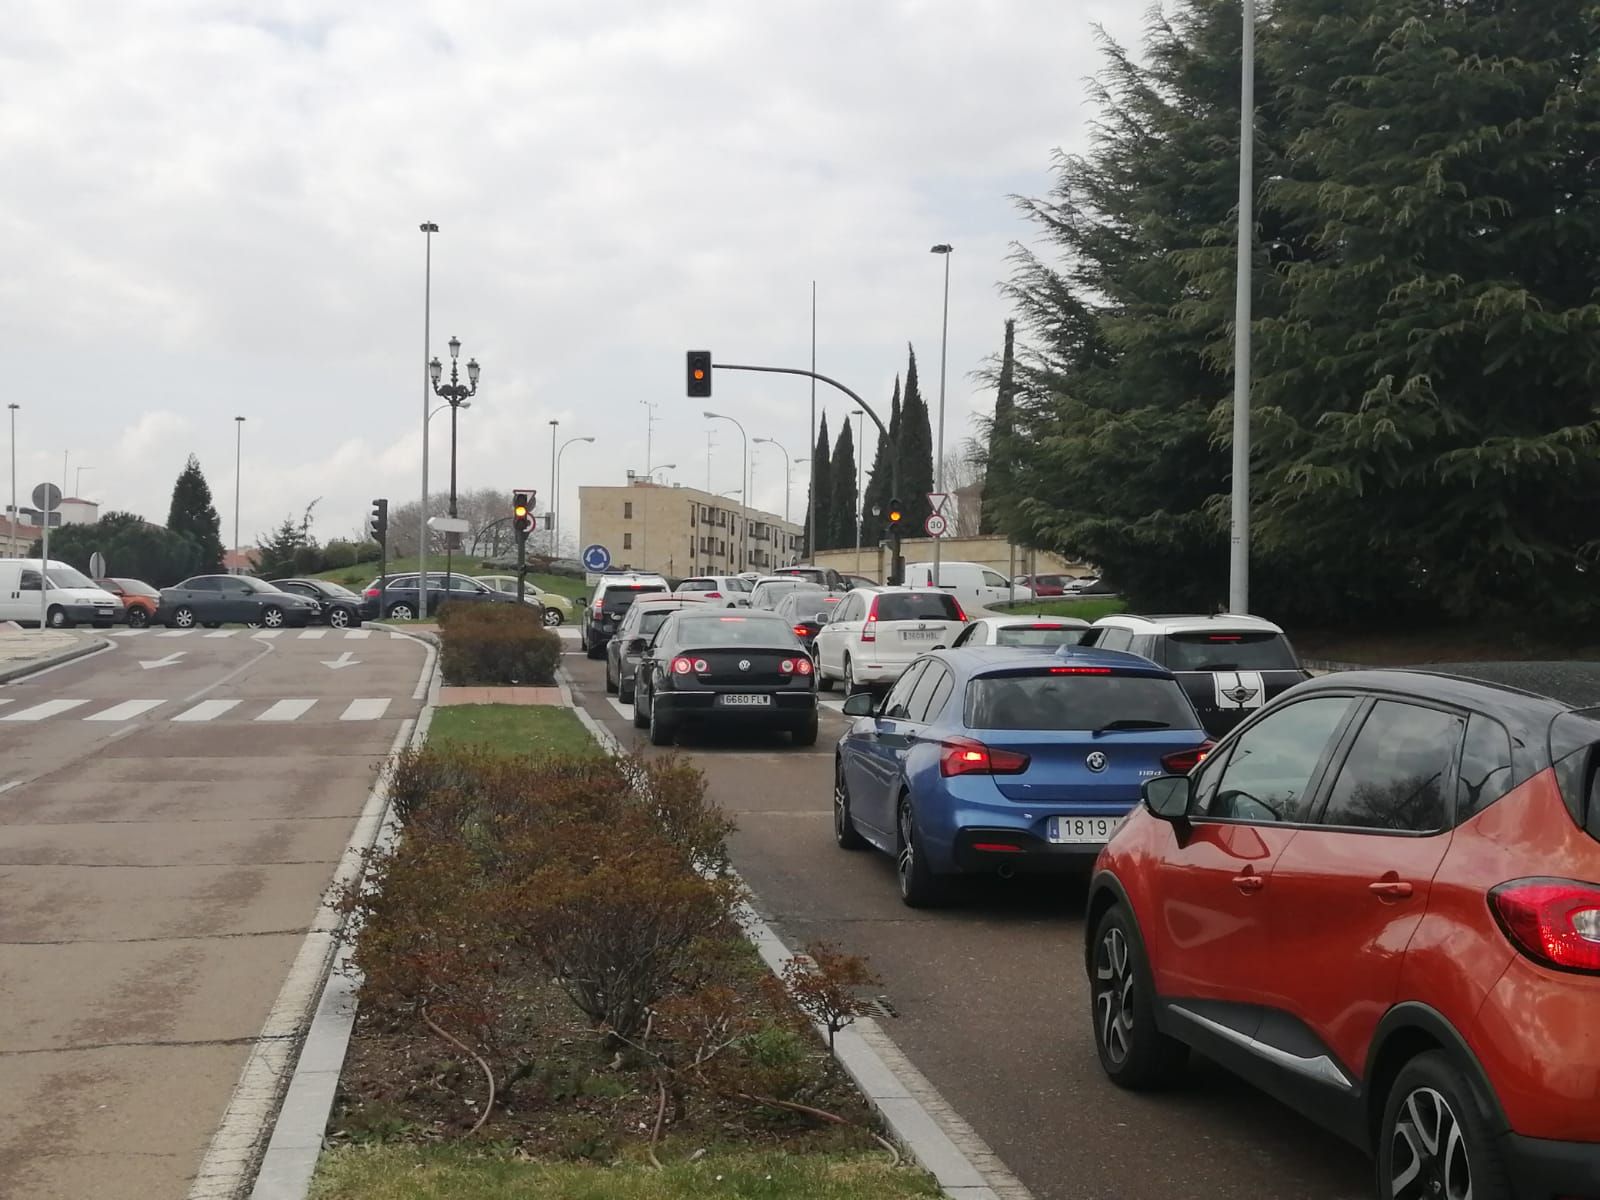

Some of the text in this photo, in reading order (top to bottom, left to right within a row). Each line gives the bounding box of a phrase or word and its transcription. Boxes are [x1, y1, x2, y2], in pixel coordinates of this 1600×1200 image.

[930, 521, 942, 529] 30
[726, 695, 749, 704] 6660
[1065, 819, 1107, 836] 1819
